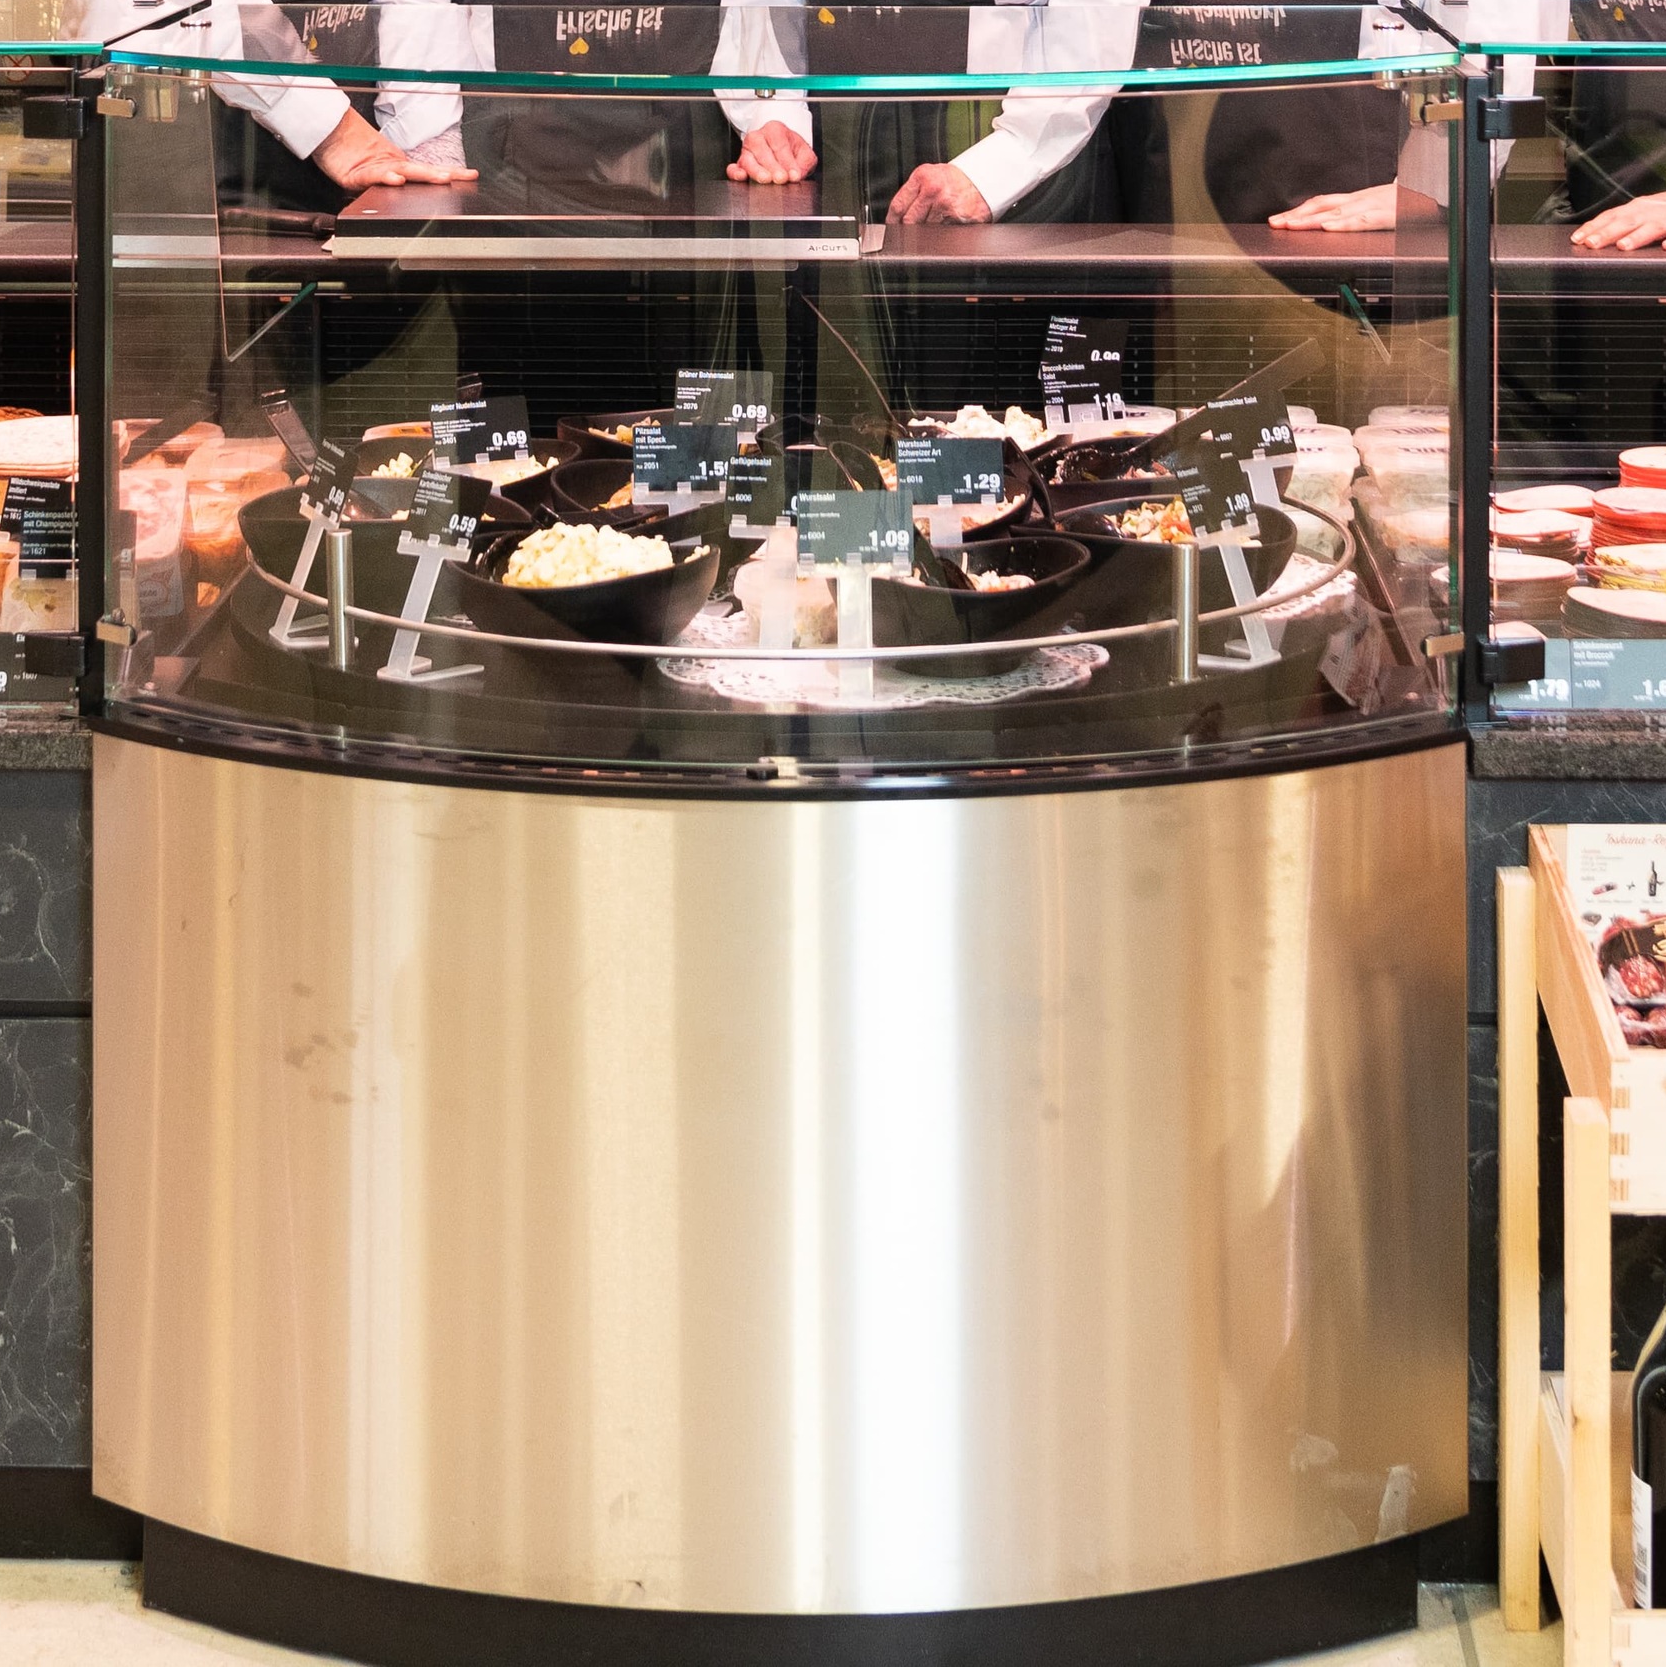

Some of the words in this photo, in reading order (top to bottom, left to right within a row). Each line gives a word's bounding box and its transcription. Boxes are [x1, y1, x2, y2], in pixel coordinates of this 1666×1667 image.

[732, 404, 767, 419] 0.69
[492, 431, 527, 446] 0.69
[1261, 425, 1290, 442] 0.99
[931, 448, 941, 457] Art
[963, 474, 1000, 489] 1.29
[1226, 493, 1250, 513] 1.89
[449, 514, 477, 532] 0.59
[868, 530, 909, 547] 1.09
[1528, 679, 1569, 697] 1.79
